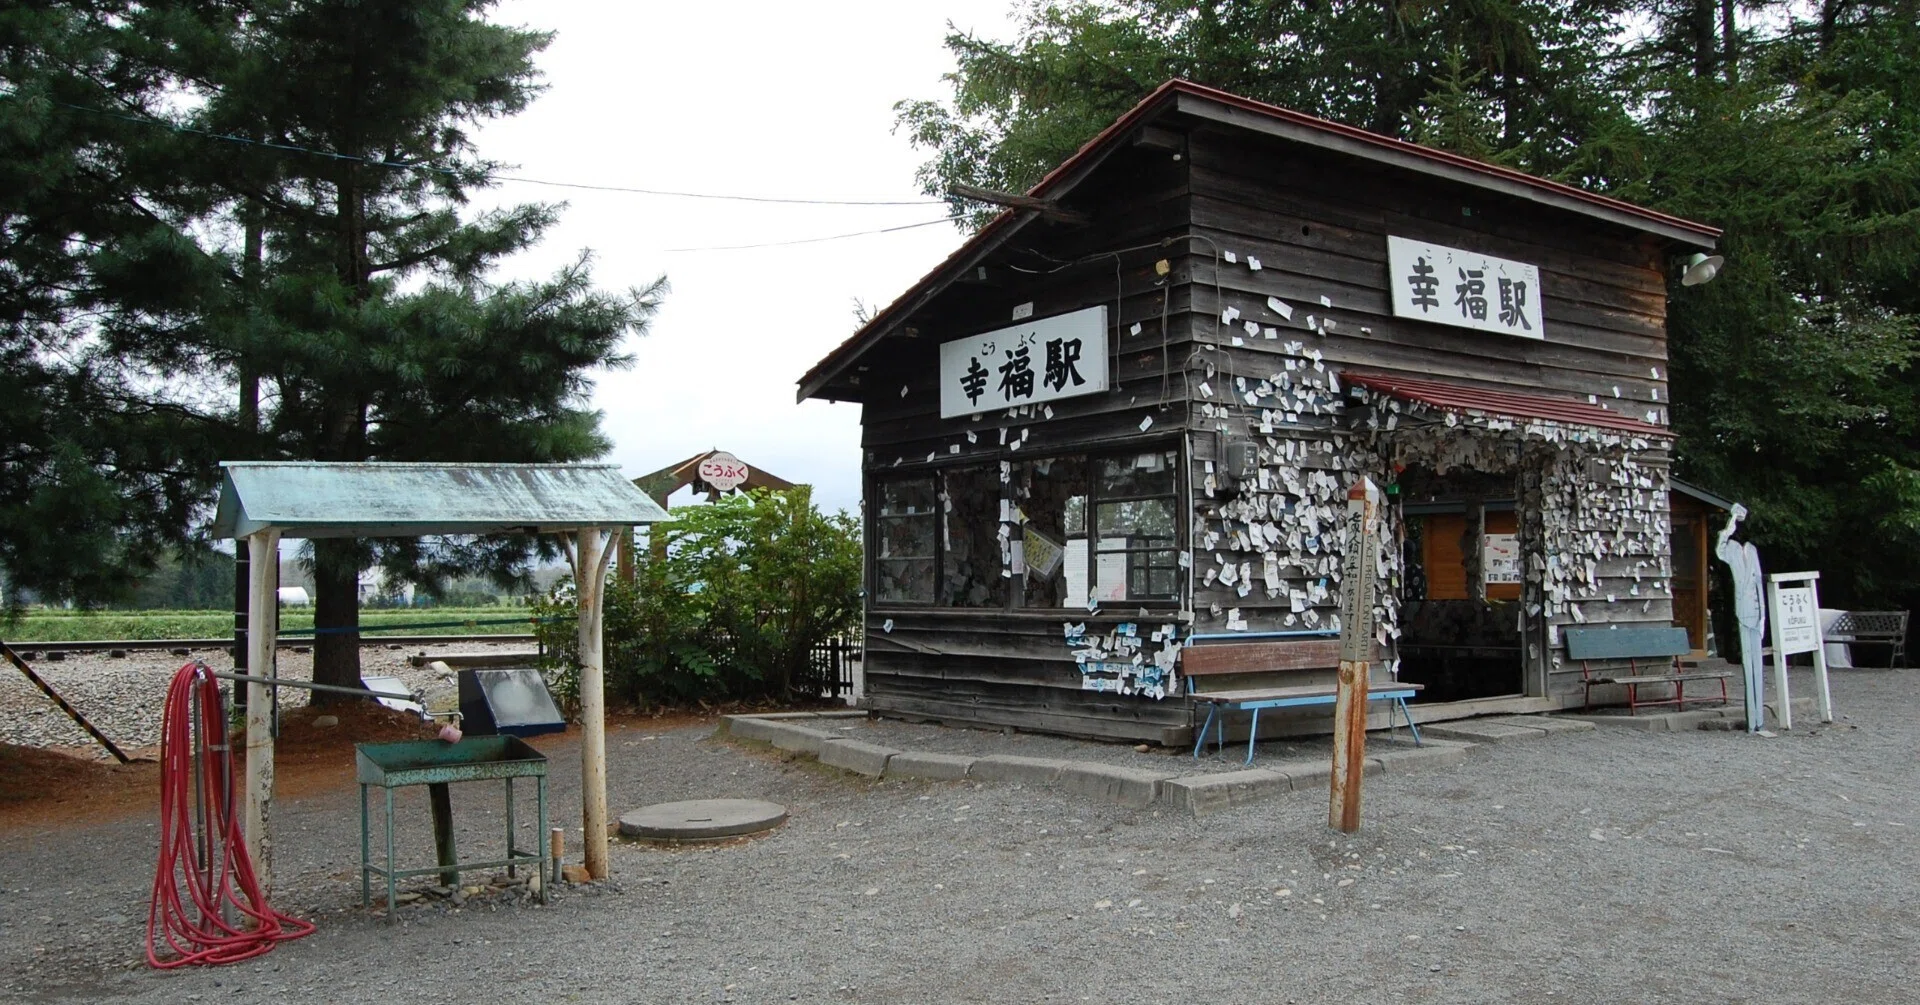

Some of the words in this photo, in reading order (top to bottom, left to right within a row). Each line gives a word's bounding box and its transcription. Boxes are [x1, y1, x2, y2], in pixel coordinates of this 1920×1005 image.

[1407, 256, 1532, 330] 幸福駅
[959, 337, 1086, 407] 幸福駅
[702, 464, 745, 479] こうふく
[1364, 564, 1373, 604] PREVAIL
[1782, 594, 1808, 605] こうふく
[1363, 605, 1371, 620] ON
[1360, 622, 1369, 657] EARTH
